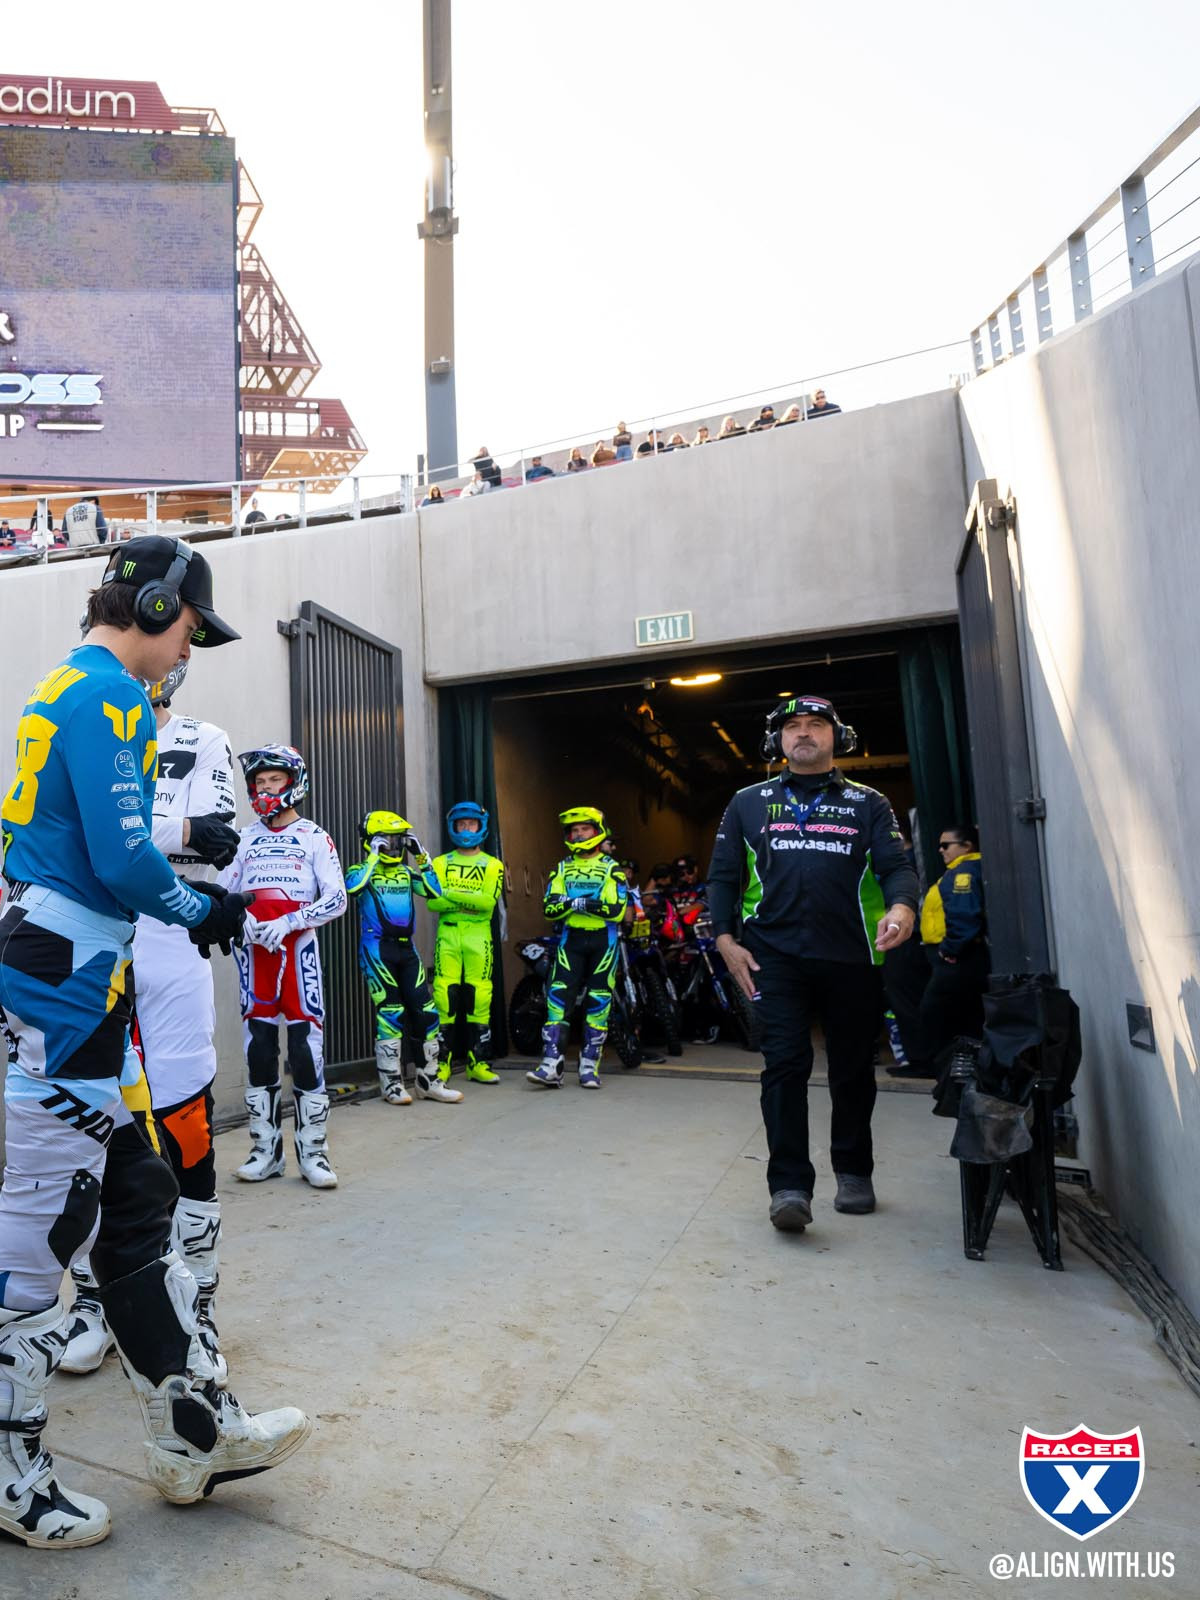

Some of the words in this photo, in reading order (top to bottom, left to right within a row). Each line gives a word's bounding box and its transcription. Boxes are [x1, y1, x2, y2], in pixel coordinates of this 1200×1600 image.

[645, 615, 684, 642] EXIT
[245, 847, 306, 860] MCR
[257, 876, 300, 884] HONDA
